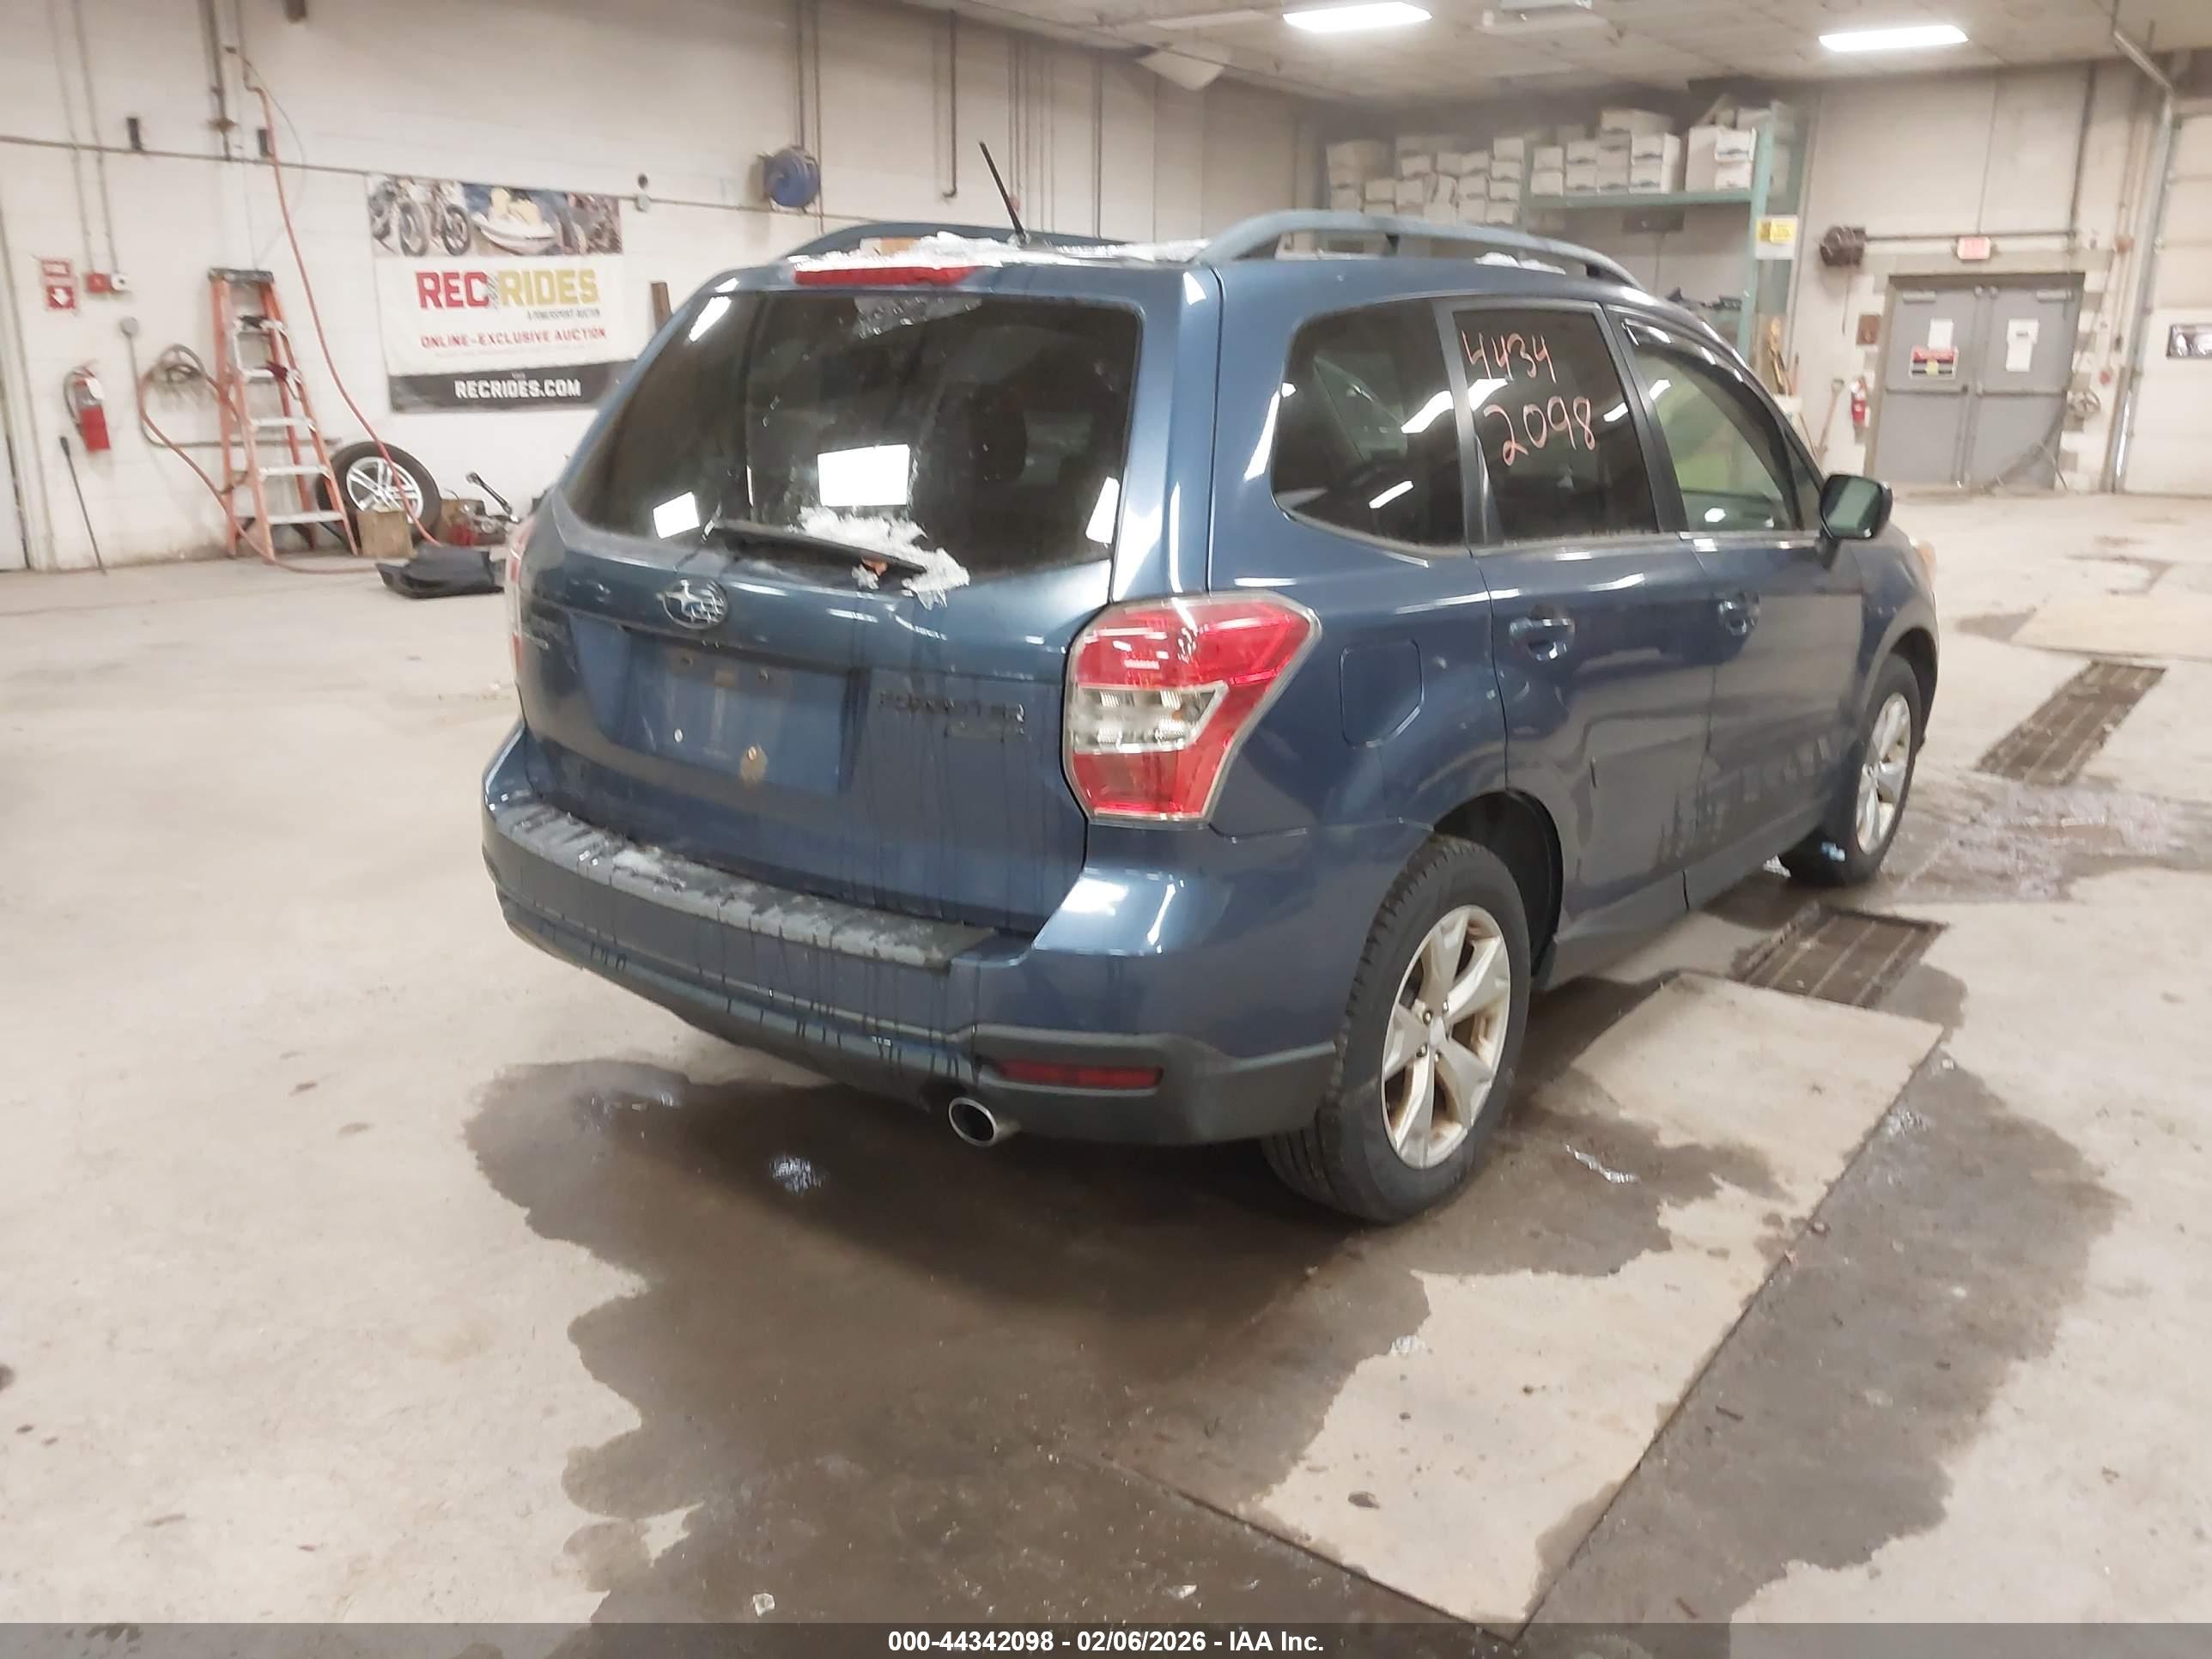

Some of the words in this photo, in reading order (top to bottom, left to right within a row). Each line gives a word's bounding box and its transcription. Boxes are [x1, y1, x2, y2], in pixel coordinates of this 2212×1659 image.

[421, 330, 550, 349] ONLINE-EXCLUSIVE
[556, 327, 606, 342] AUCTION
[1462, 330, 1557, 384] 4434
[454, 380, 581, 399] RECRIDES.COM
[1483, 396, 1595, 466] 2098
